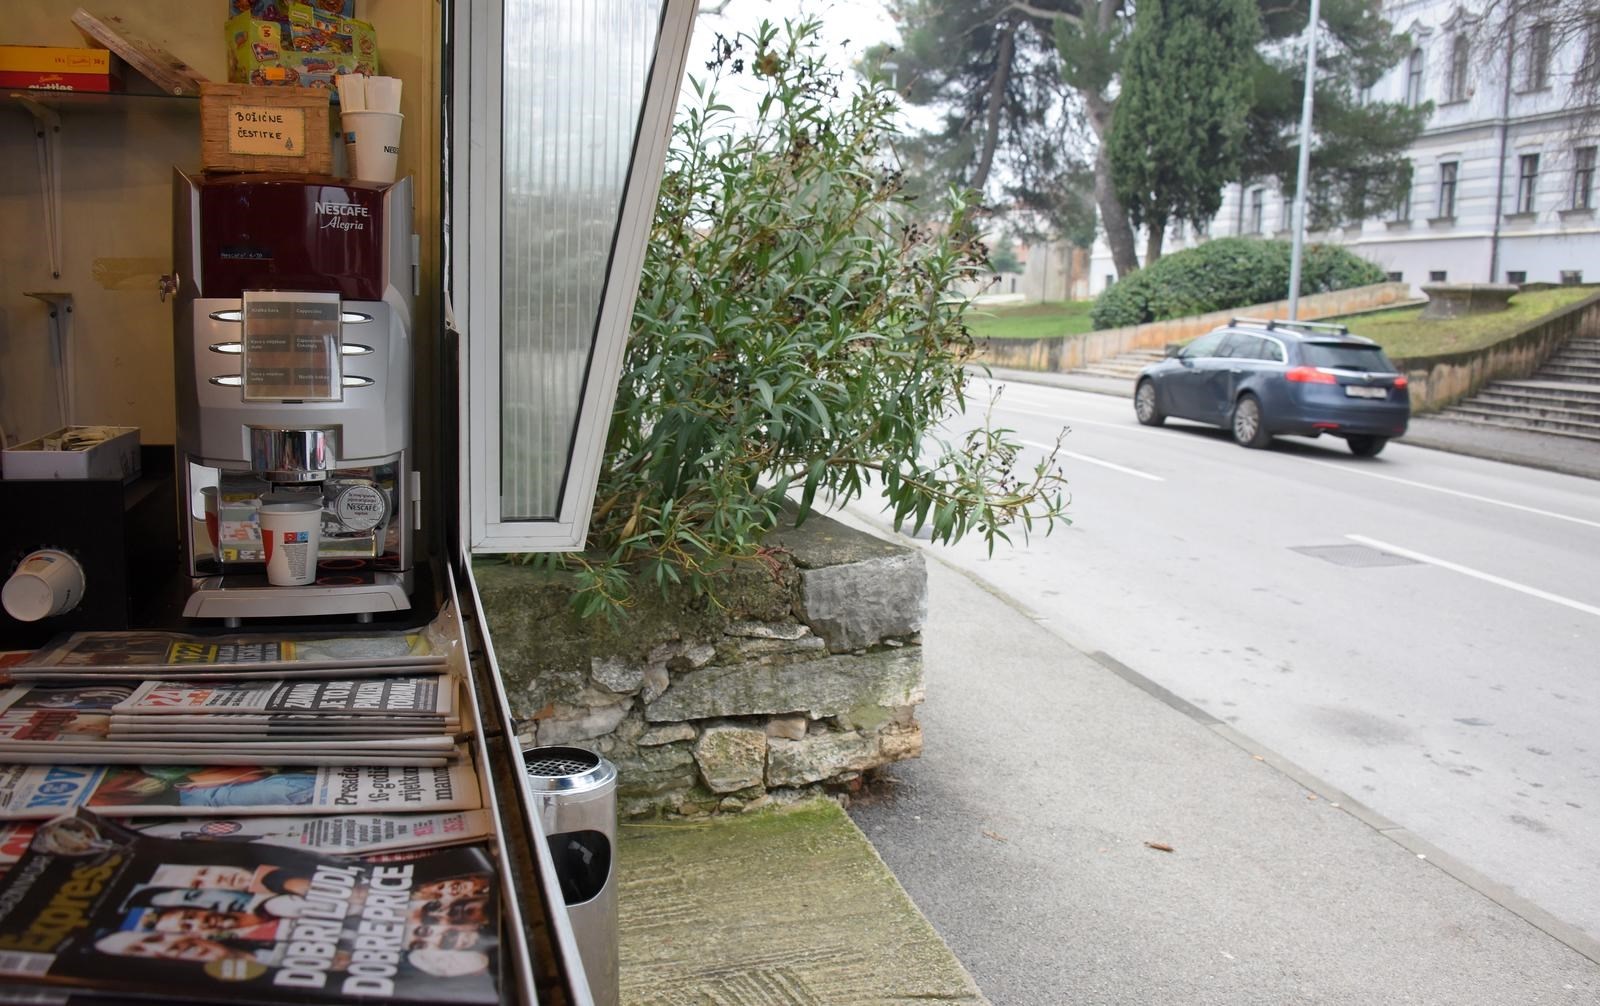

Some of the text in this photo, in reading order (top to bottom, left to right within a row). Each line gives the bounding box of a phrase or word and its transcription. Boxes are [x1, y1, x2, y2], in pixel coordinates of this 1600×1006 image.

[237, 127, 282, 140] ČESTITKE
[320, 216, 364, 231] Alegria
[318, 700, 347, 709] JE
[322, 690, 350, 700] TO
[26, 767, 87, 808] NOV
[334, 766, 359, 805] Presađe
[361, 864, 414, 922] PRIČE
[273, 864, 366, 988] DOBRI LJUDI,
[341, 921, 405, 997] DOBRE
